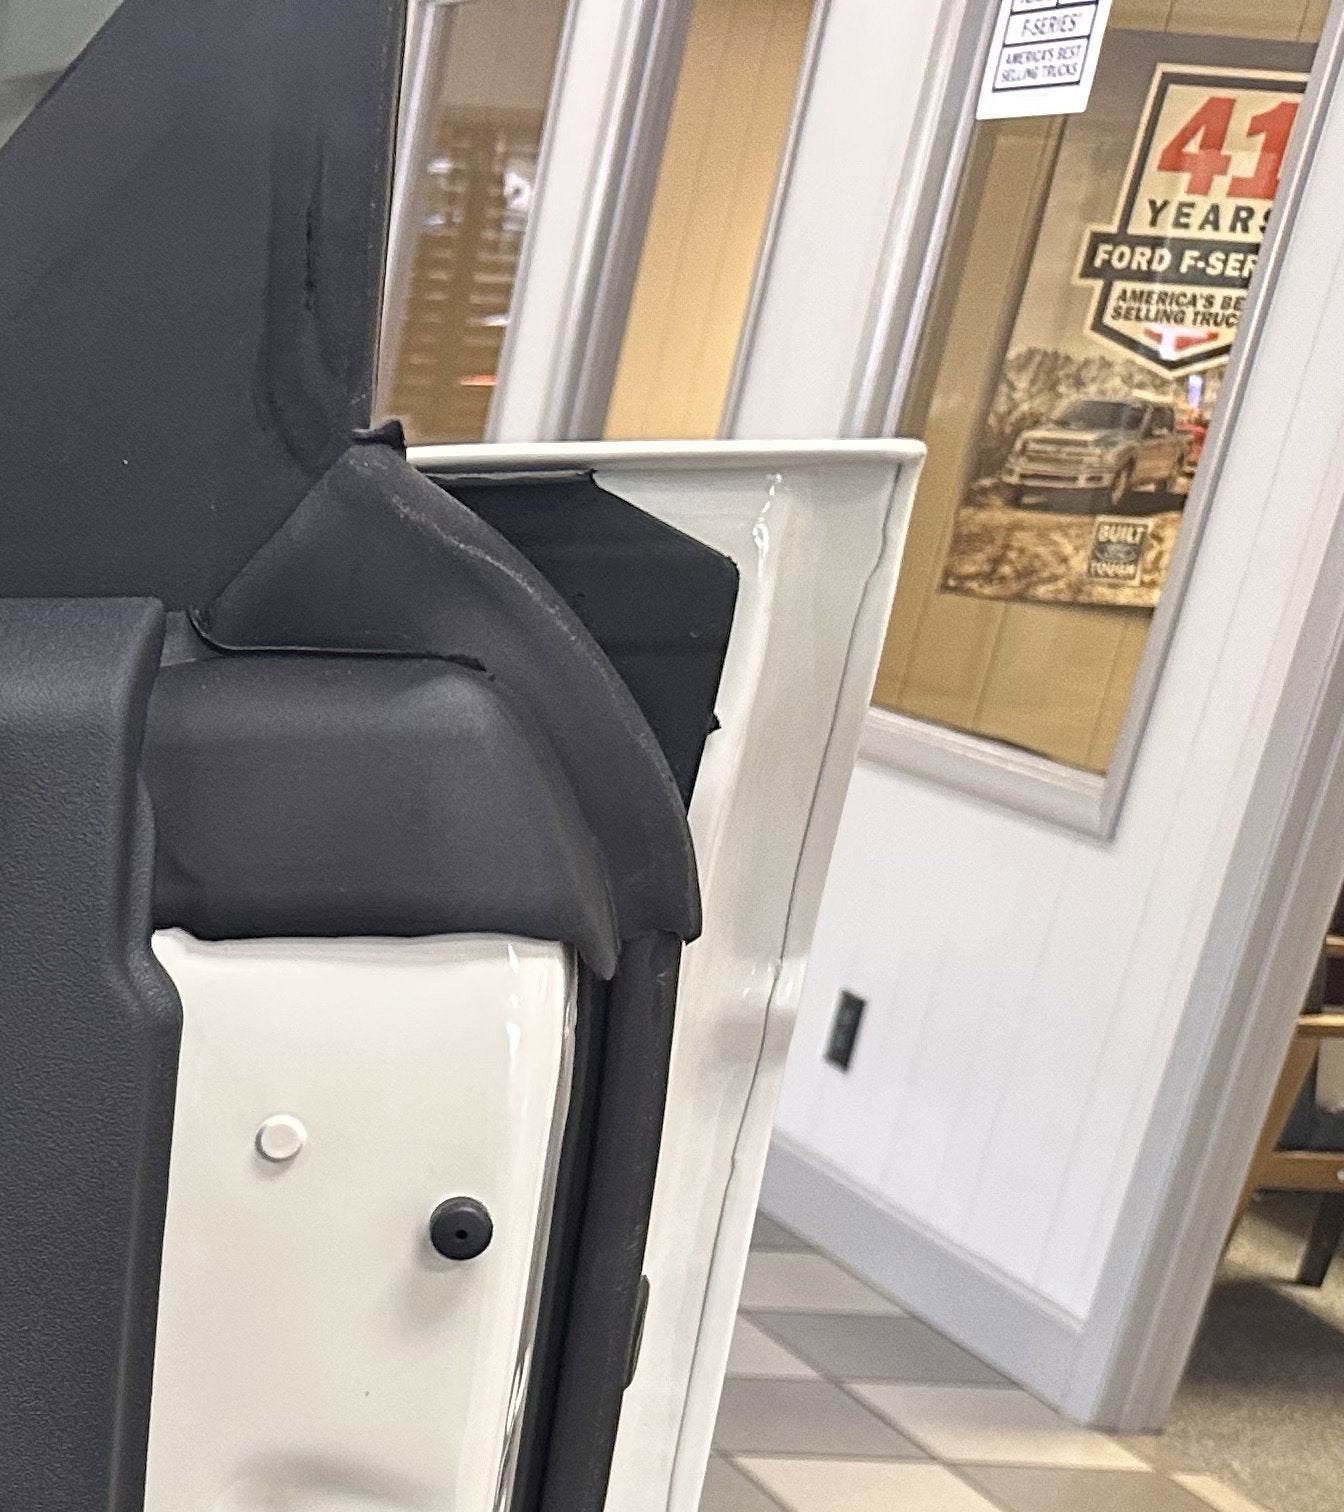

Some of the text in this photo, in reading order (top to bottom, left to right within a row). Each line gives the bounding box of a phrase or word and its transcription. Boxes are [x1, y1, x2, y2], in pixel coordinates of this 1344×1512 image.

[1056, 44, 1082, 61] BEST
[1001, 62, 1078, 82] SELLING TRUCKS
[1157, 96, 1299, 199] 41
[1093, 243, 1172, 271] FORD
[1115, 287, 1215, 309] AMERICA'S
[1110, 304, 1186, 325] SELLING
[1098, 525, 1144, 543] BUILT
